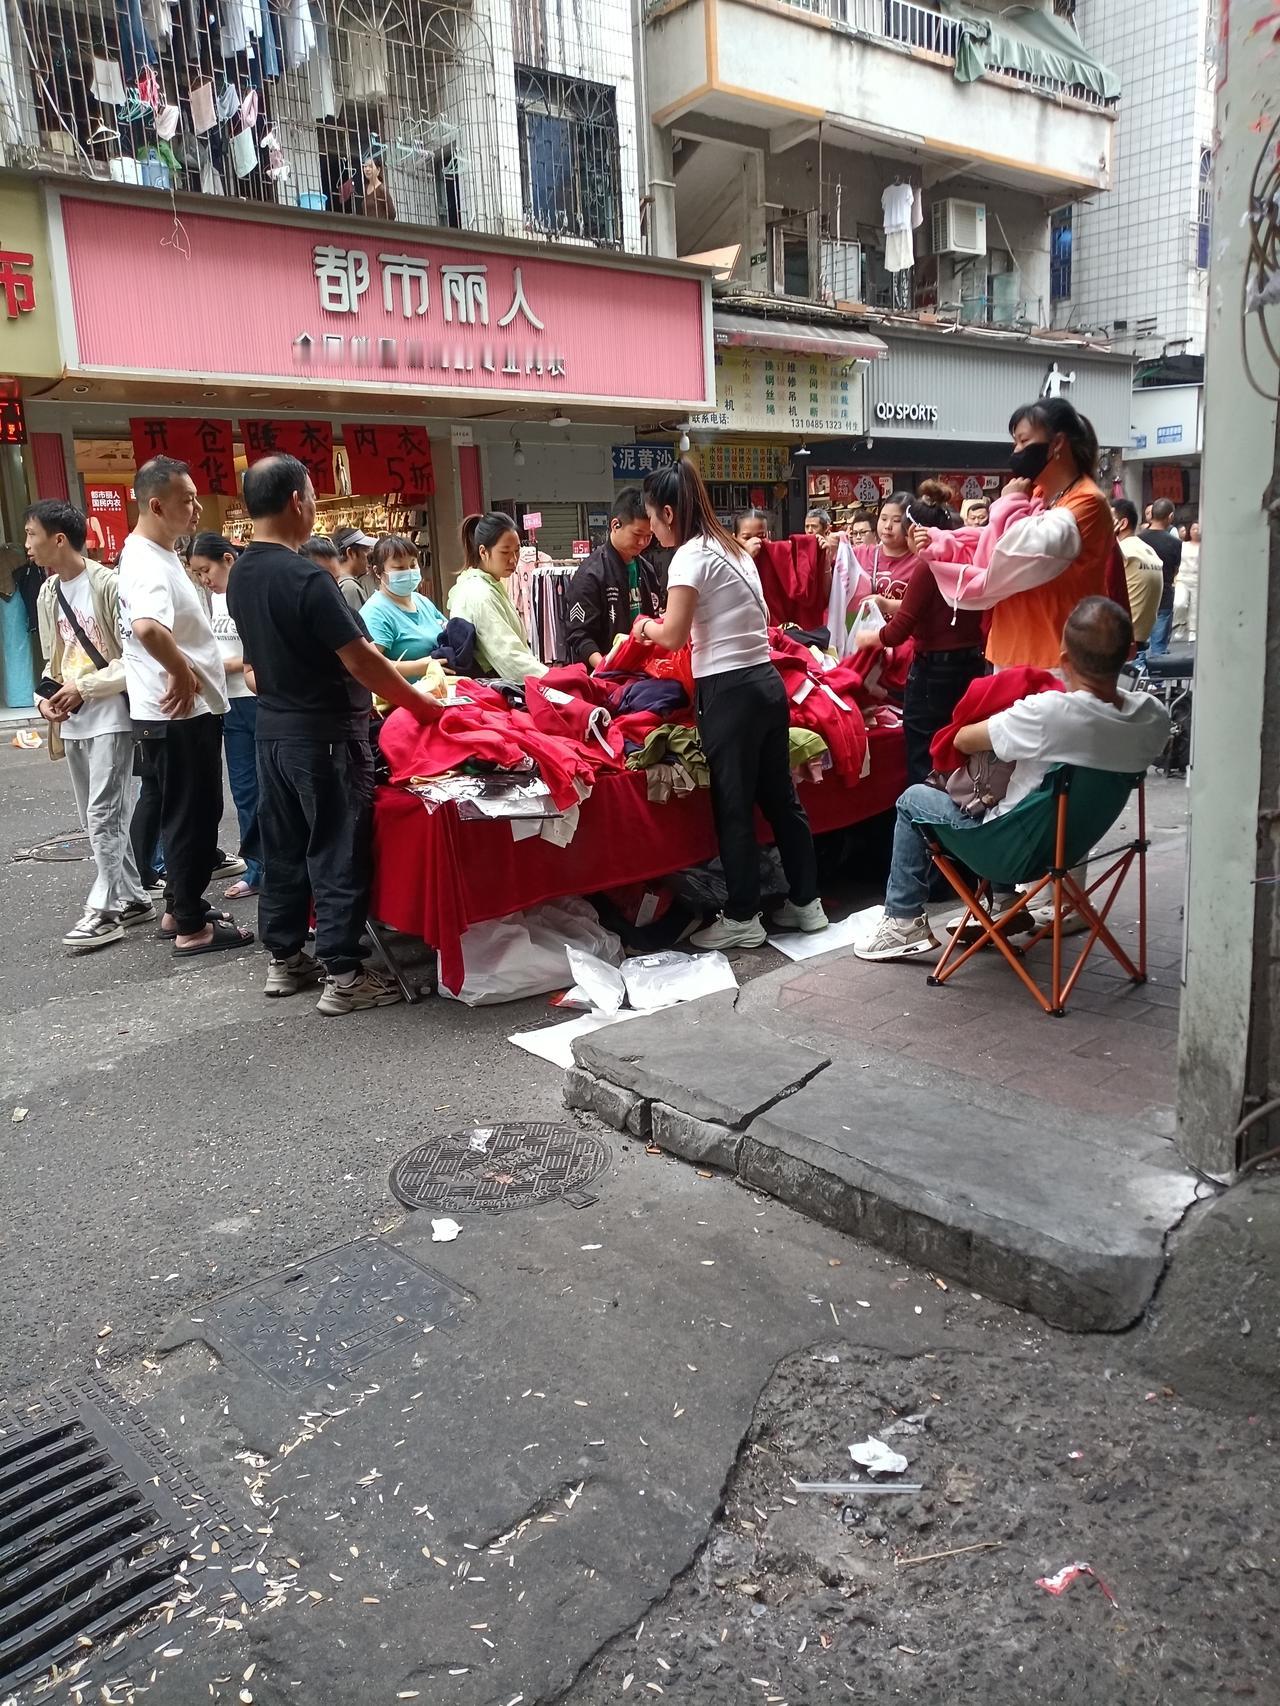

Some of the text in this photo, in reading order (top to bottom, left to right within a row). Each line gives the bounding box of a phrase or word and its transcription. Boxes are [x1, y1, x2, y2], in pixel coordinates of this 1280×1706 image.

[312, 246, 545, 330] 都市丽人
[787, 362, 797, 416] 维修吊机
[877, 402, 938, 421] QD SPORTS
[143, 420, 226, 453] 开仓
[247, 421, 333, 454] 睡衣
[354, 425, 427, 456] 内衣
[90, 490, 121, 499] 都市丽人
[92, 499, 122, 508] 国民内衣
